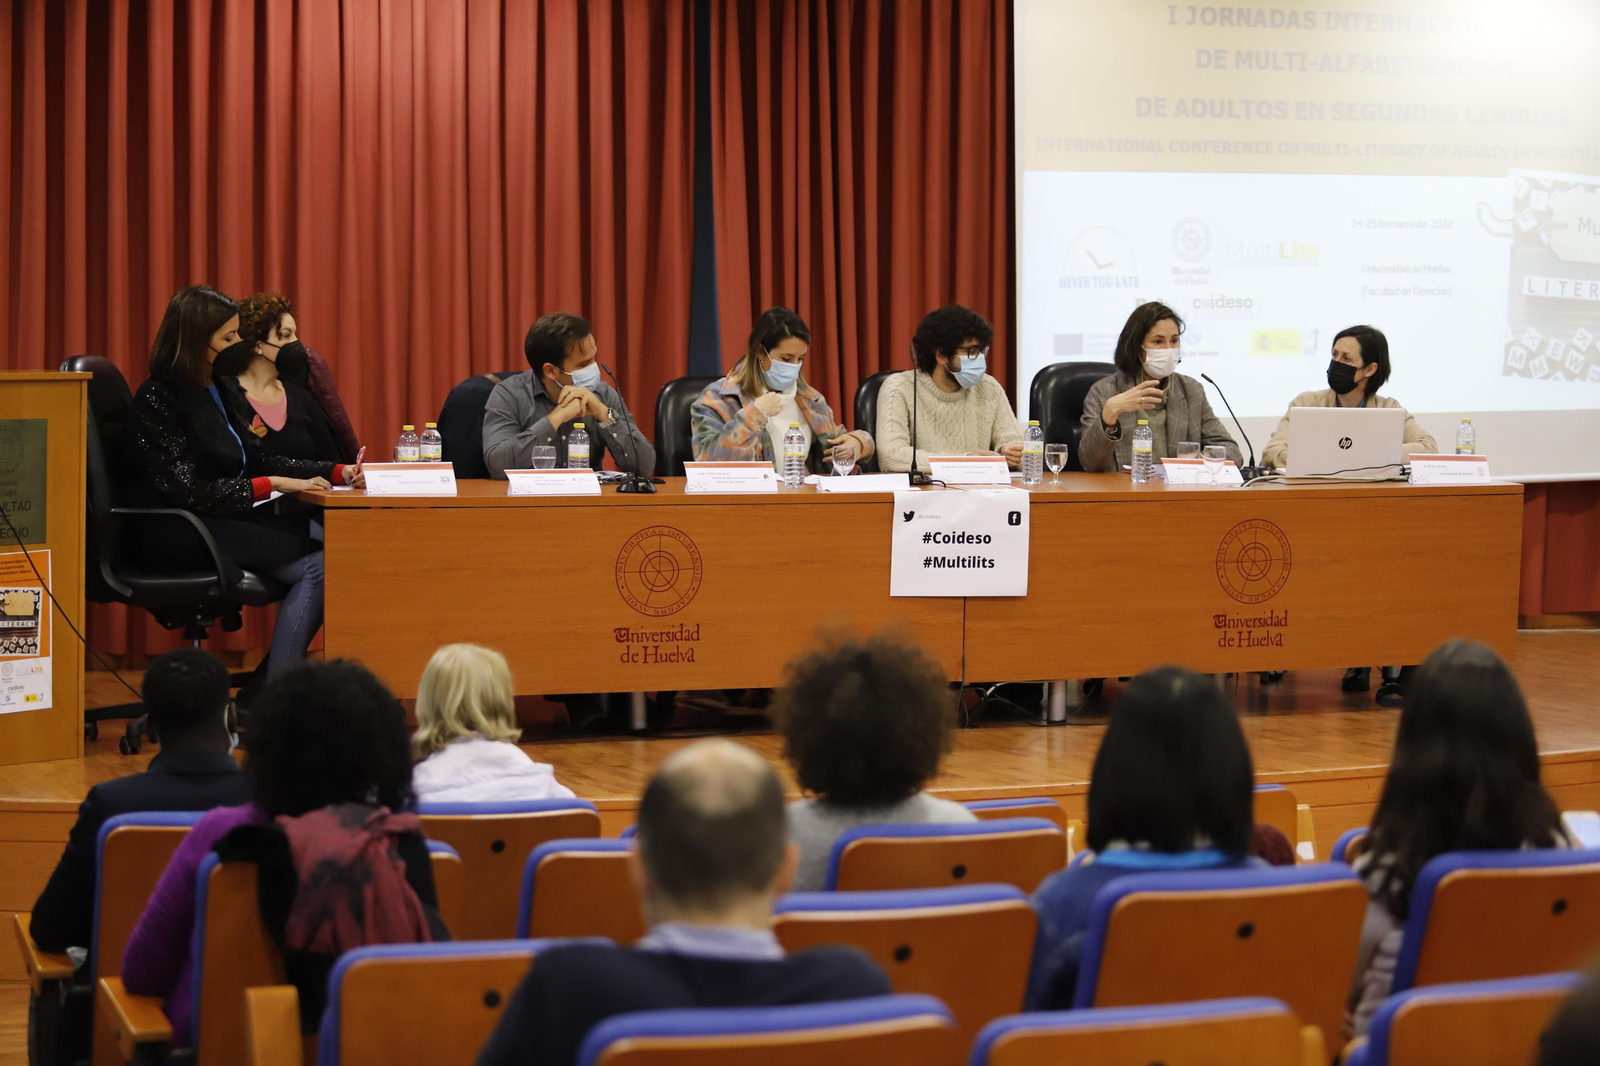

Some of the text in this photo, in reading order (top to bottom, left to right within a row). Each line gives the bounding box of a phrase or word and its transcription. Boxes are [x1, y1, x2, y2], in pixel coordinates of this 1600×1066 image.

[1167, 5, 1546, 38] I JORNADAS INTERNACIONS
[1196, 48, 1228, 70] DE
[1136, 97, 1569, 126] DE ADULTOS EN SEGUNDAS LENGUAS
[1035, 137, 1165, 154] INTERNATIONAL
[1168, 139, 1273, 155] CONFERENCE
[1278, 141, 1299, 155] ON
[1303, 141, 1427, 158] MULTI-LITERACY
[1429, 144, 1449, 158] OF
[1452, 144, 1509, 159] ADULTS
[1512, 146, 1529, 159] IN
[1532, 146, 1590, 160] SECOND
[1059, 276, 1139, 289] NEVER TOO LATE
[922, 531, 992, 545] #Coideso
[923, 556, 995, 569] #Multilits
[1213, 610, 1288, 629] Universidad
[614, 623, 701, 643] Universidad
[1218, 630, 1283, 648] de Huelva
[620, 645, 696, 664] de Huelva
